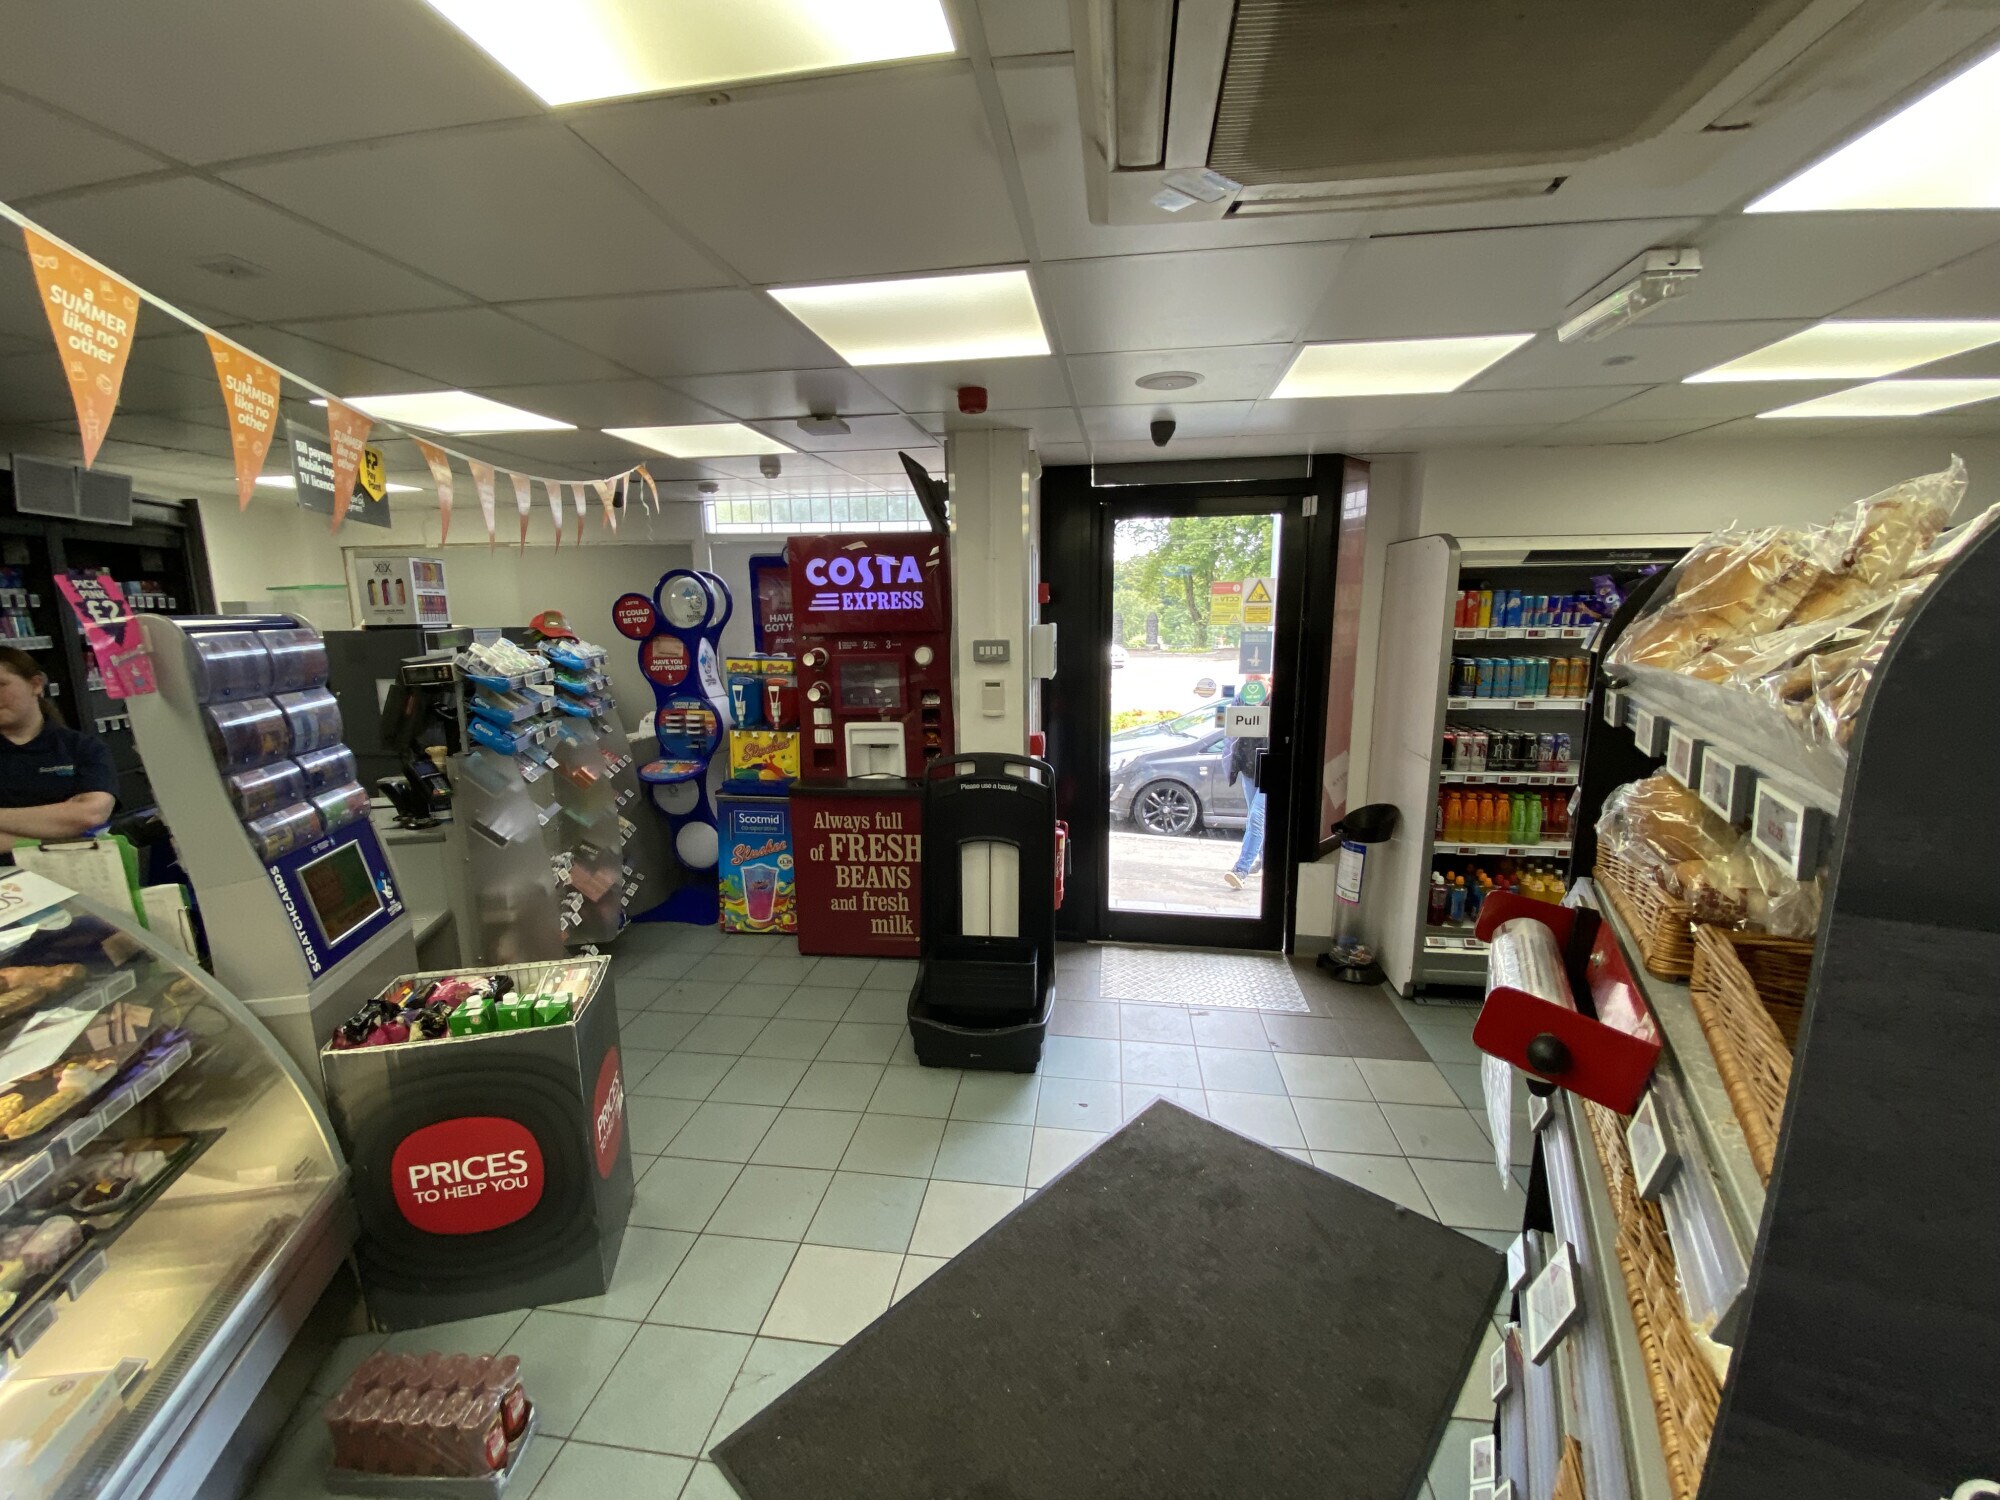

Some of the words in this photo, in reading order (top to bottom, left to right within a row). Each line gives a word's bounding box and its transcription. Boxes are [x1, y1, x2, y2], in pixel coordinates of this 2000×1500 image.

[83, 287, 94, 303] a
[49, 284, 127, 336] SUMMER
[62, 309, 94, 338] like
[95, 329, 119, 349] no
[68, 335, 115, 364] other
[245, 373, 253, 385] a
[226, 374, 275, 409] SUMMER
[234, 392, 254, 414] like
[255, 405, 270, 420] no
[237, 412, 268, 433] other
[295, 439, 308, 455] Bill
[333, 429, 364, 451] SUMMER
[336, 443, 349, 458] like
[349, 451, 358, 461] no
[298, 455, 323, 475] Mobile
[337, 458, 356, 471] other
[299, 471, 310, 485] TV
[806, 555, 923, 589] COSTA
[72, 579, 103, 589] PICK
[79, 590, 110, 600] PINK
[841, 591, 924, 611] EXPRESS
[86, 600, 128, 624] £2
[626, 608, 650, 616] COULD
[769, 613, 793, 622] HAVE
[765, 623, 785, 632] GOT
[786, 623, 794, 631] Y
[838, 641, 842, 650] 1
[863, 641, 868, 650] 2
[886, 640, 891, 649] 3
[1235, 715, 1260, 726] Pull
[997, 782, 1018, 792] basket
[738, 813, 780, 824] Scotmid
[813, 811, 871, 833] Always
[875, 811, 903, 830] full
[740, 825, 778, 833] co-operative
[809, 844, 825, 861] of
[828, 833, 921, 862] FRESH
[835, 865, 911, 889] BEANS
[830, 895, 857, 911] and
[862, 890, 910, 912] fresh
[270, 865, 322, 973] SCRATCHCARDS
[871, 914, 914, 935] milk
[597, 1069, 619, 1142] PRICES
[408, 1149, 528, 1189] PRICES
[413, 1189, 440, 1204] TO
[444, 1182, 487, 1200] HELP
[490, 1175, 529, 1192] YOU
